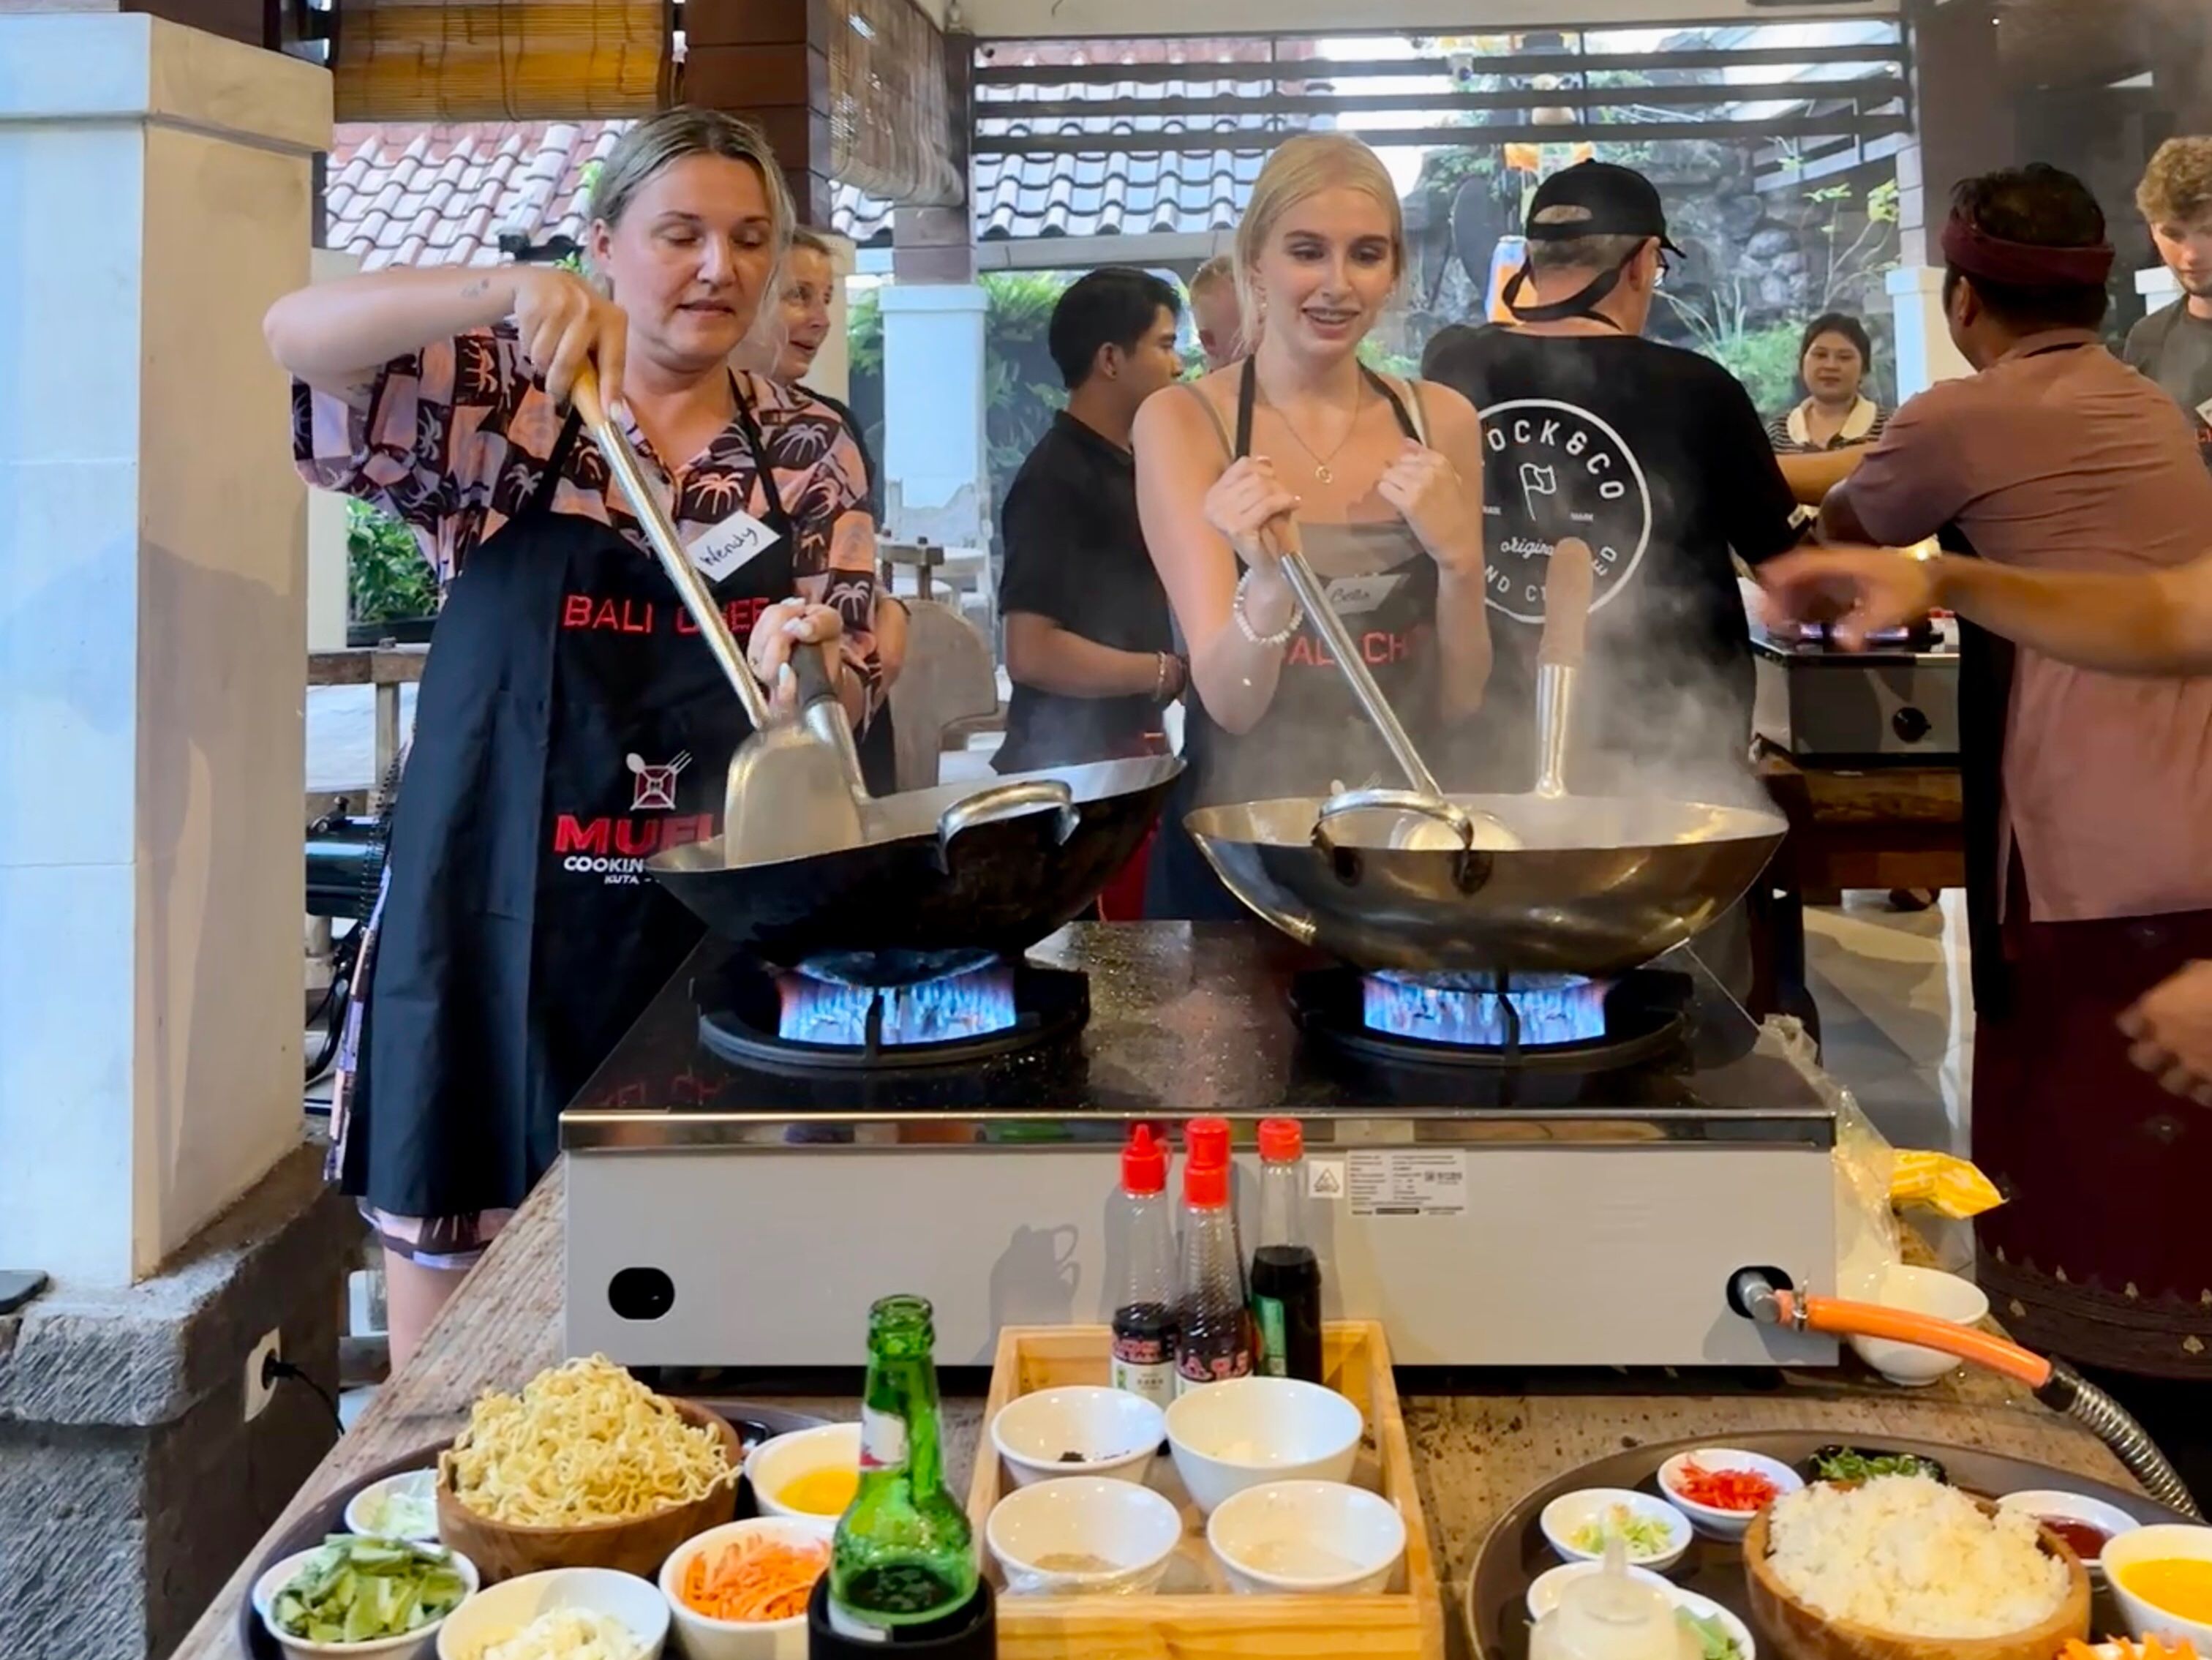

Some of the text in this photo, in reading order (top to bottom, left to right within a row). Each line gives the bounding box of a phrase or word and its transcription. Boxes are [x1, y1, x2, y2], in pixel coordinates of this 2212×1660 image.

[1486, 418, 1625, 500] OCK&CO
[700, 525, 759, 566] Wendy
[1485, 565, 1511, 593] ND
[563, 594, 770, 634] BALI CEF
[1288, 635, 1336, 666] AL
[563, 855, 644, 873] COOKIN
[603, 874, 640, 885] KUTA
